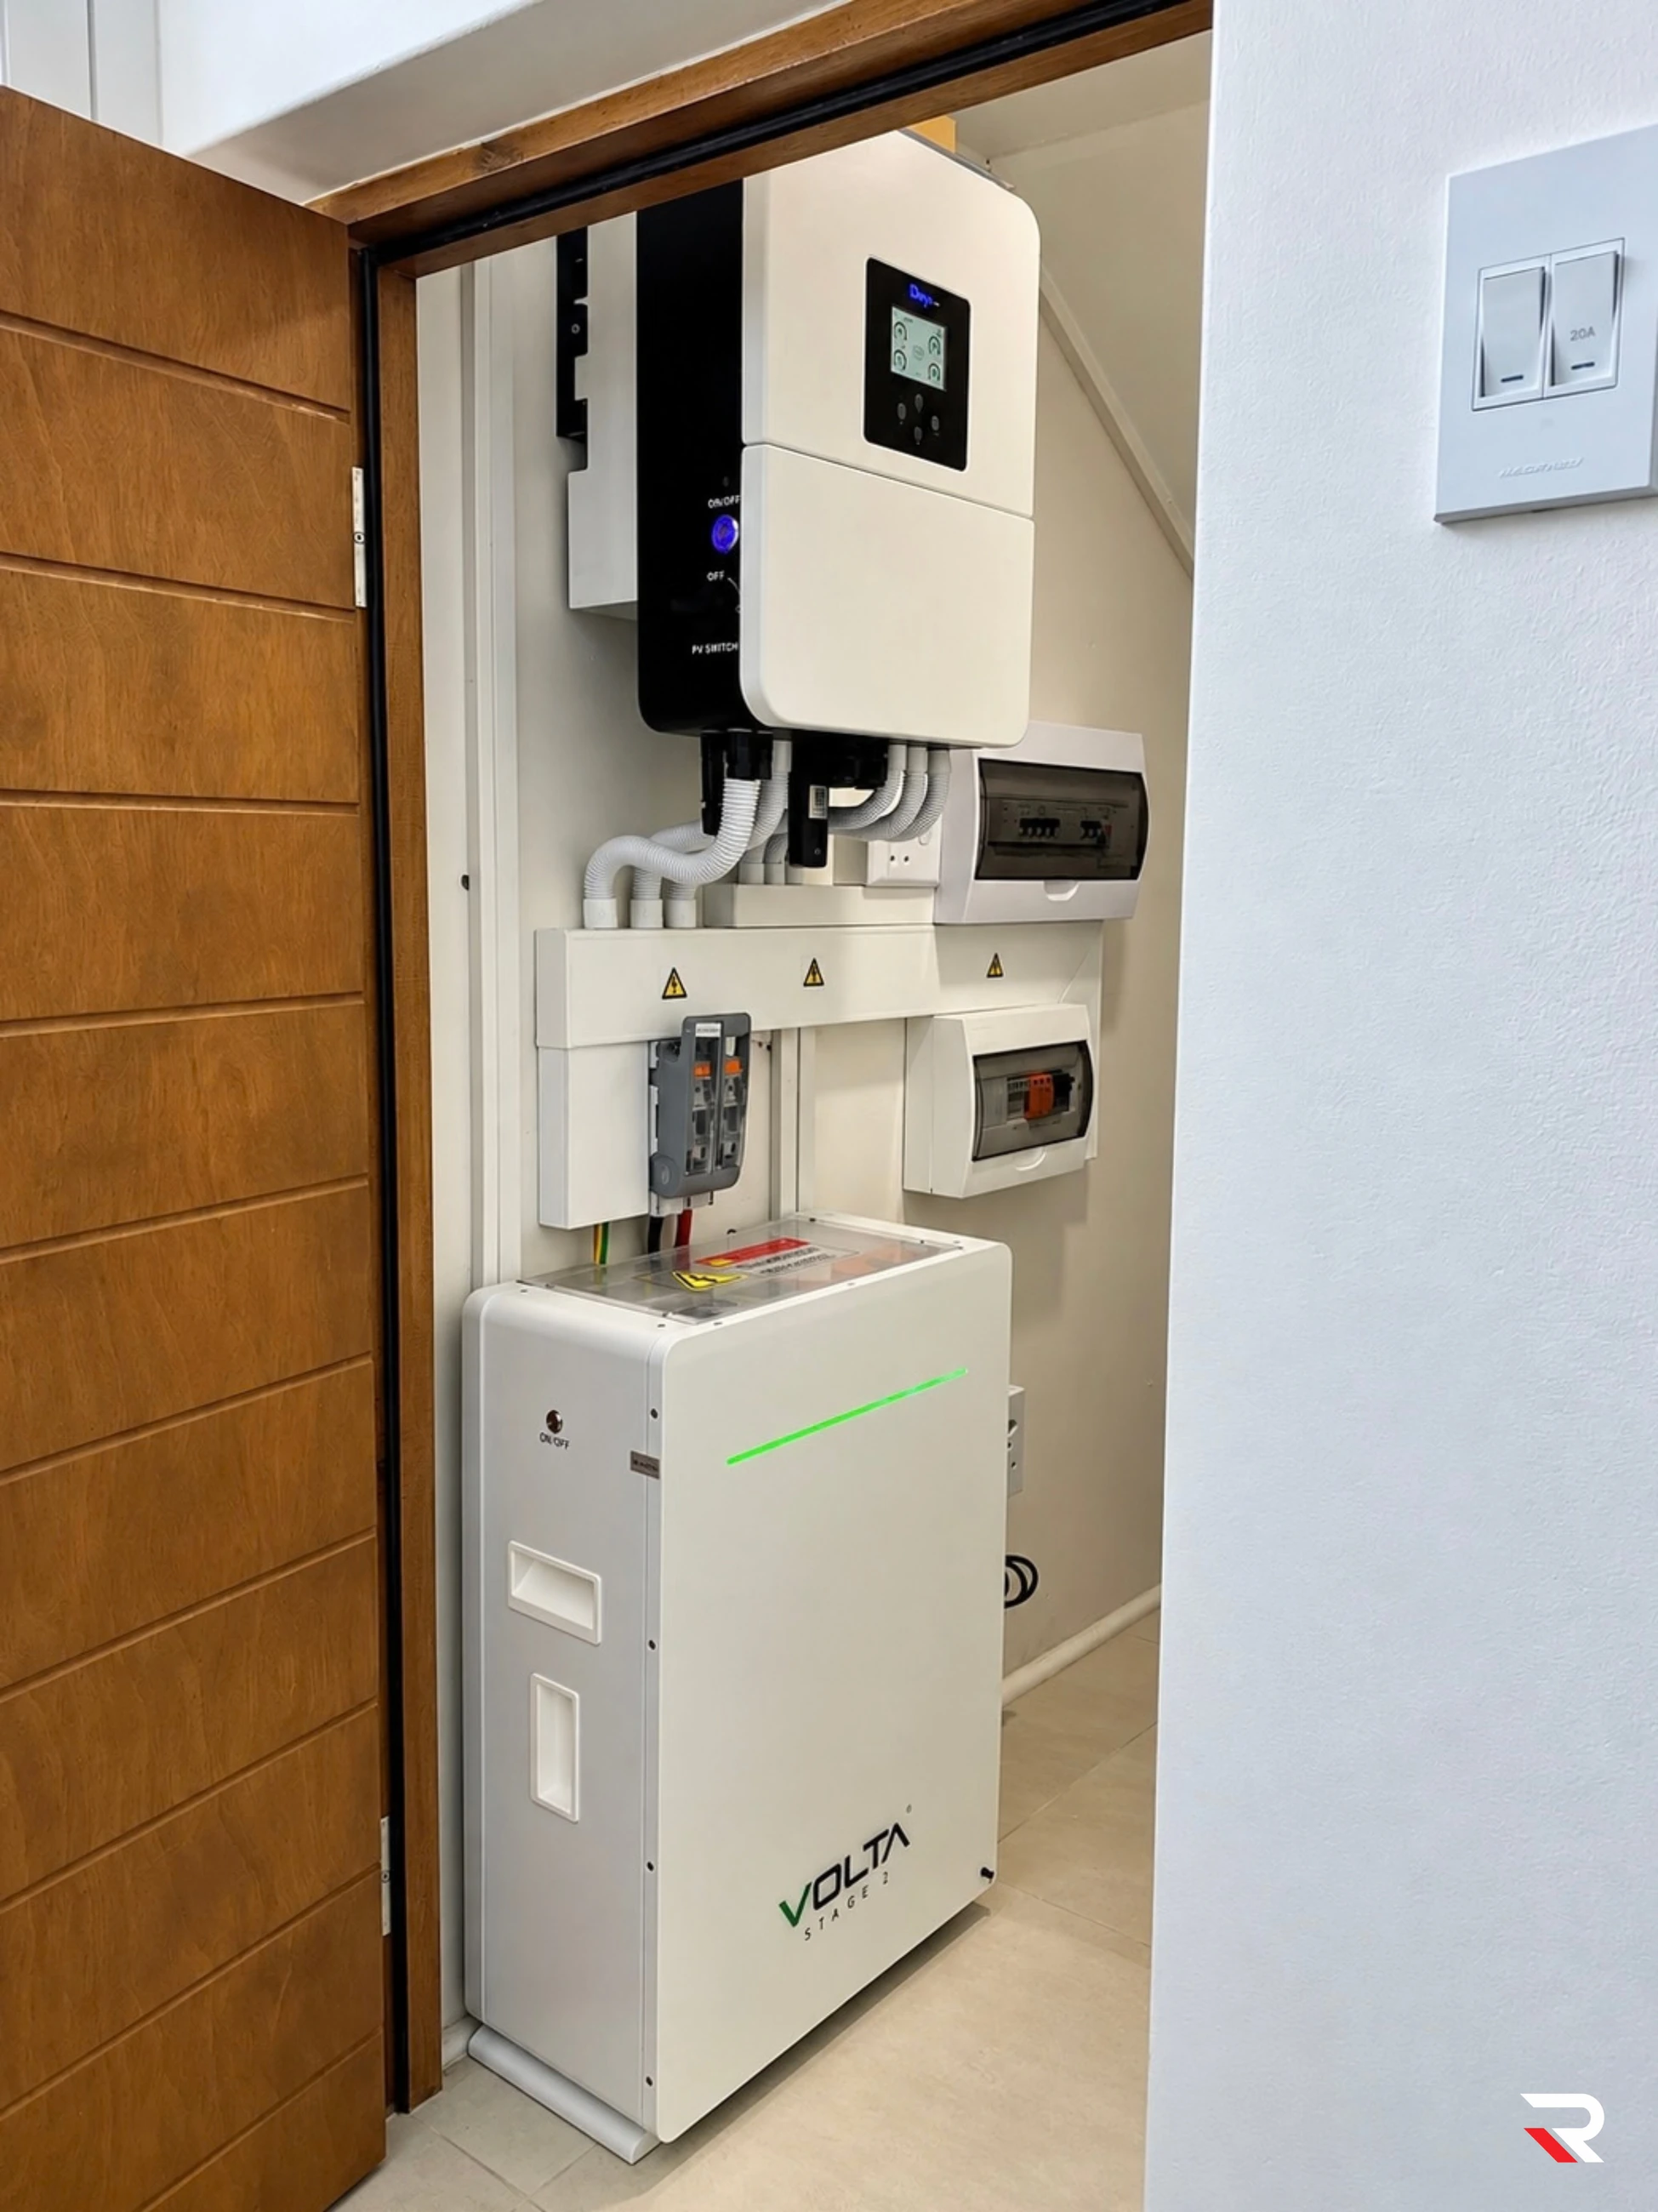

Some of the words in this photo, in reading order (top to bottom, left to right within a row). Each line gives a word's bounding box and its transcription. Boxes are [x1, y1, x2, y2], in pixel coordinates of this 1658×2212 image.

[1570, 326, 1595, 341] 20A
[708, 494, 741, 509] ON/OFF
[707, 571, 725, 582] OFF
[692, 644, 704, 655] PV
[705, 641, 738, 655] SWITCH
[778, 1821, 910, 1928] VOLTA
[804, 1884, 869, 1941] STAGE
[882, 1871, 889, 1885] 2
